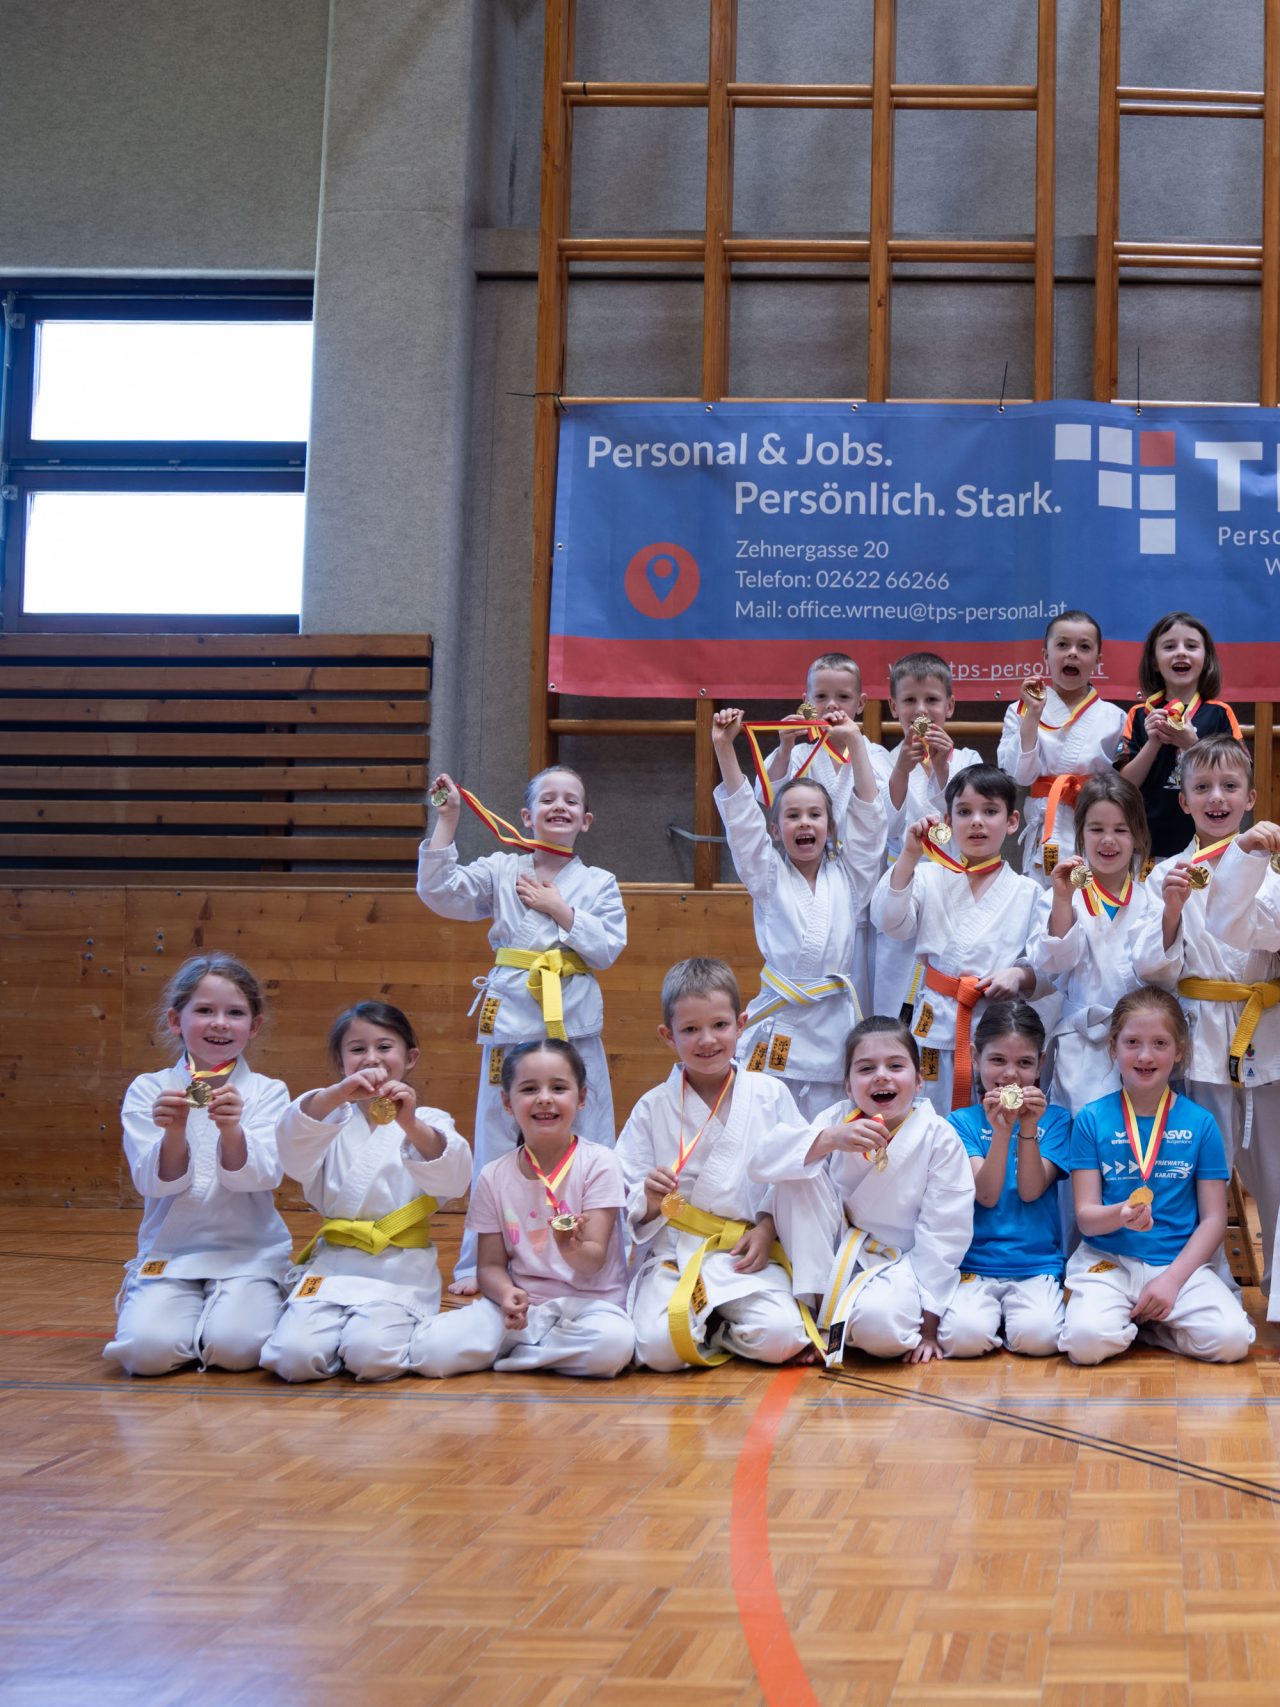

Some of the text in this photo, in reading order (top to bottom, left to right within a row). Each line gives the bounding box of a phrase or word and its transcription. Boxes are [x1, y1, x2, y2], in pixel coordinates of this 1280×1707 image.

[588, 432, 893, 468] Personal & Jobs.
[735, 481, 1063, 517] Persönlich. Stark.
[735, 540, 889, 562] Zehnergasse 20
[735, 570, 950, 591] Telefon: 02622 66266
[735, 600, 1068, 624] Mail: office.wrneu@tps-personal.at
